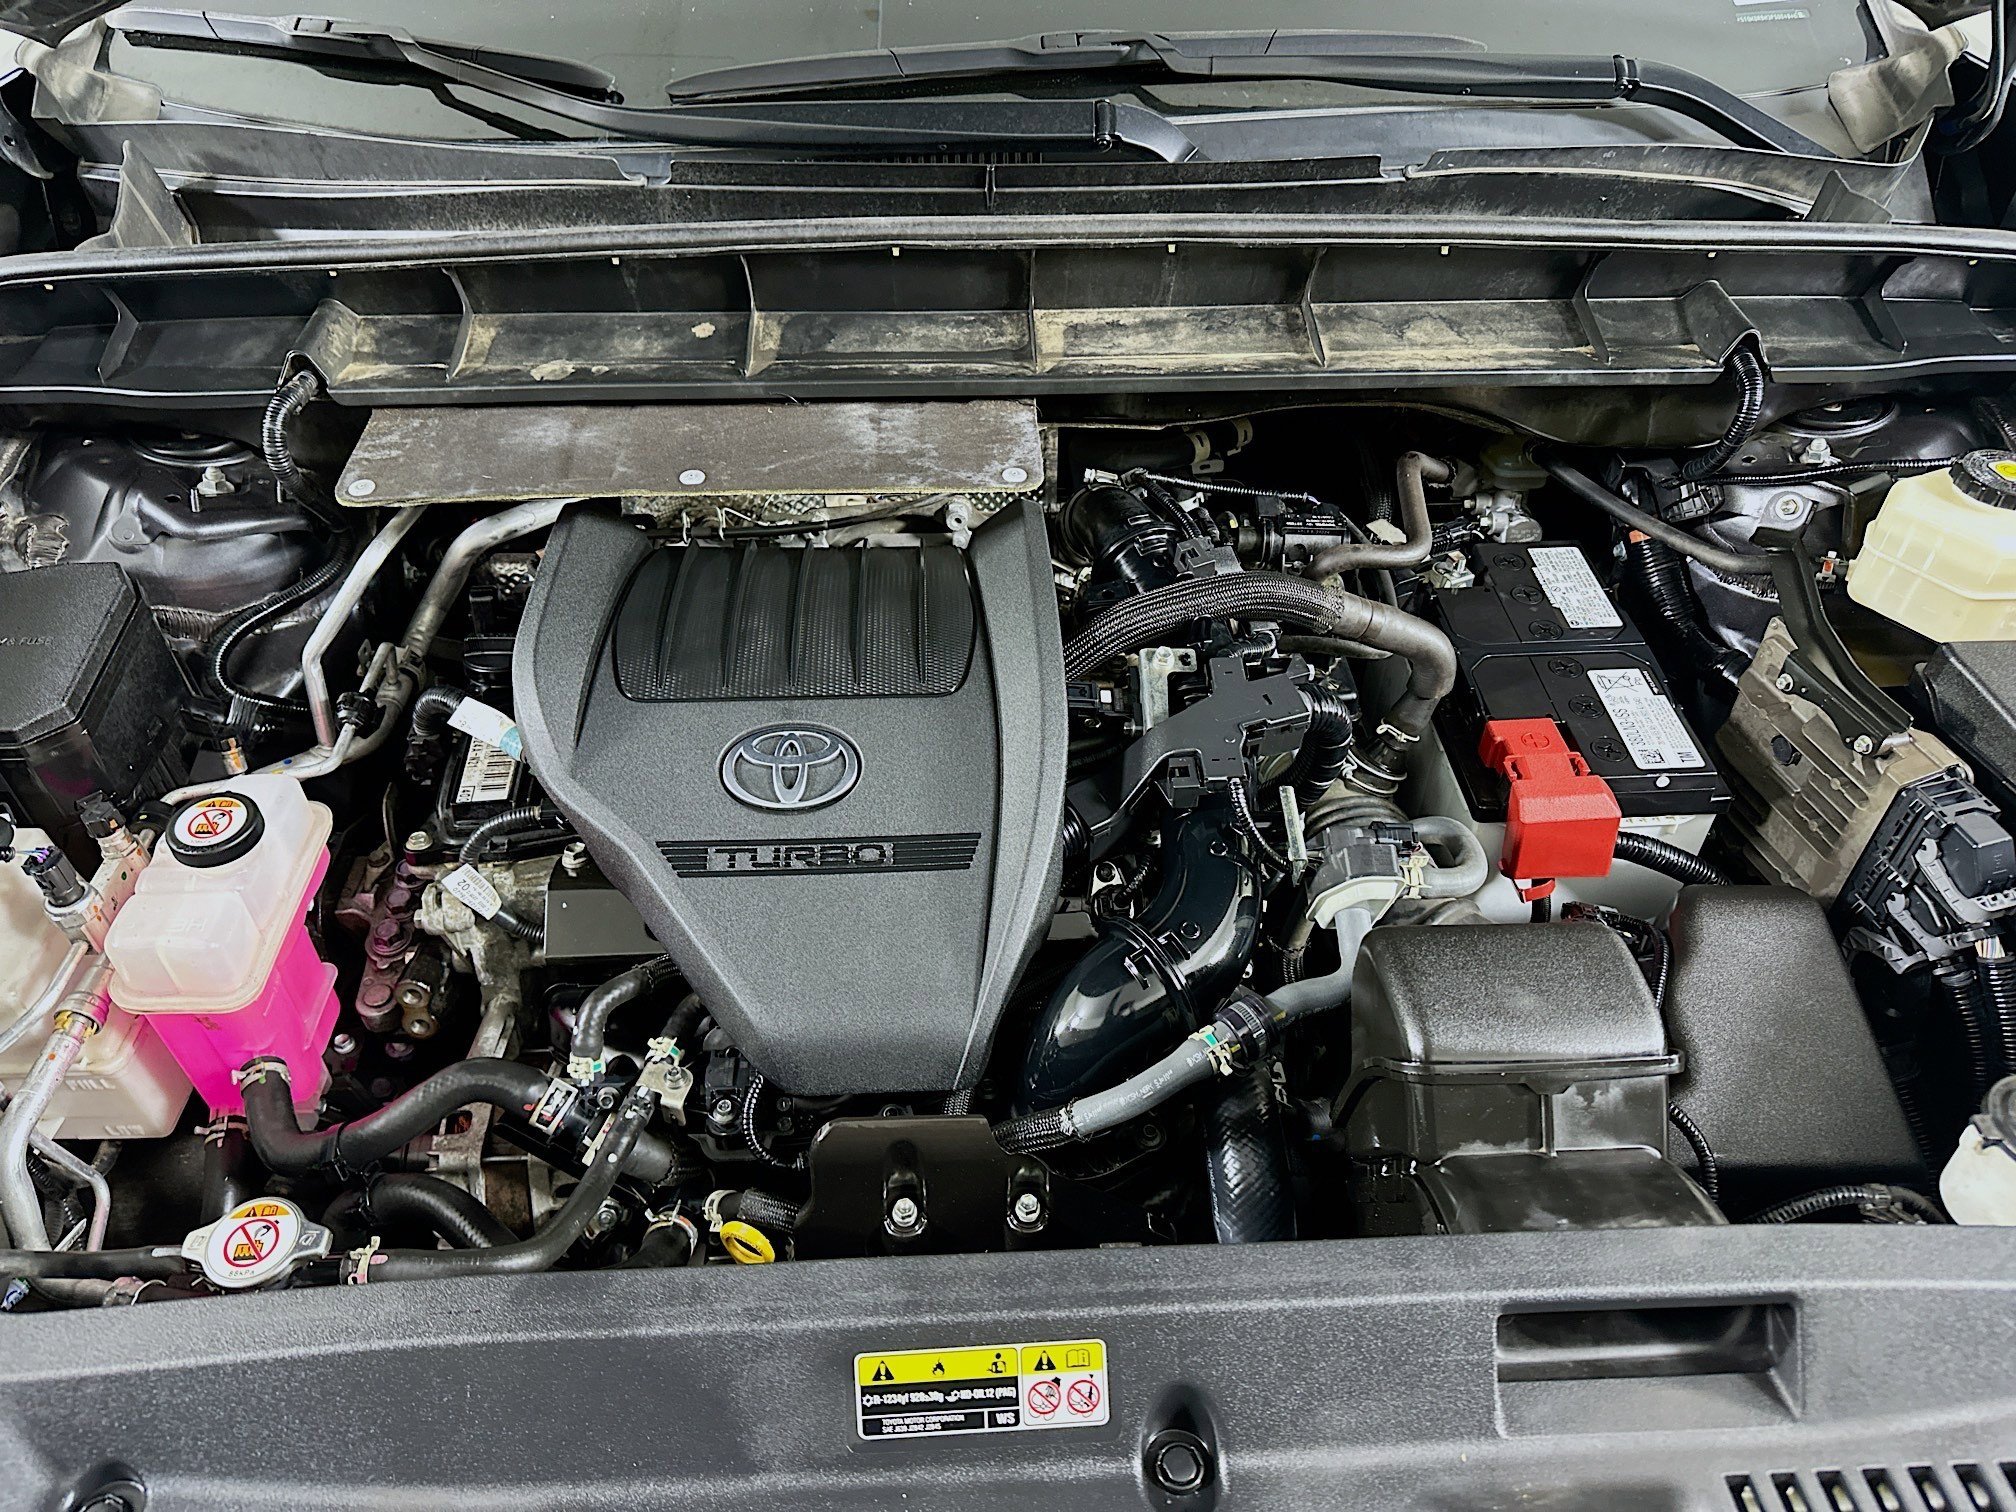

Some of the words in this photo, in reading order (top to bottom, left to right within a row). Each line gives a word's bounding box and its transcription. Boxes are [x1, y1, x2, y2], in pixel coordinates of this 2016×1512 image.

[713, 844, 888, 868] TURBO
[881, 1418, 904, 1426] TOYOTA
[903, 1416, 925, 1425] MOTOR
[995, 1411, 1016, 1425] WS
